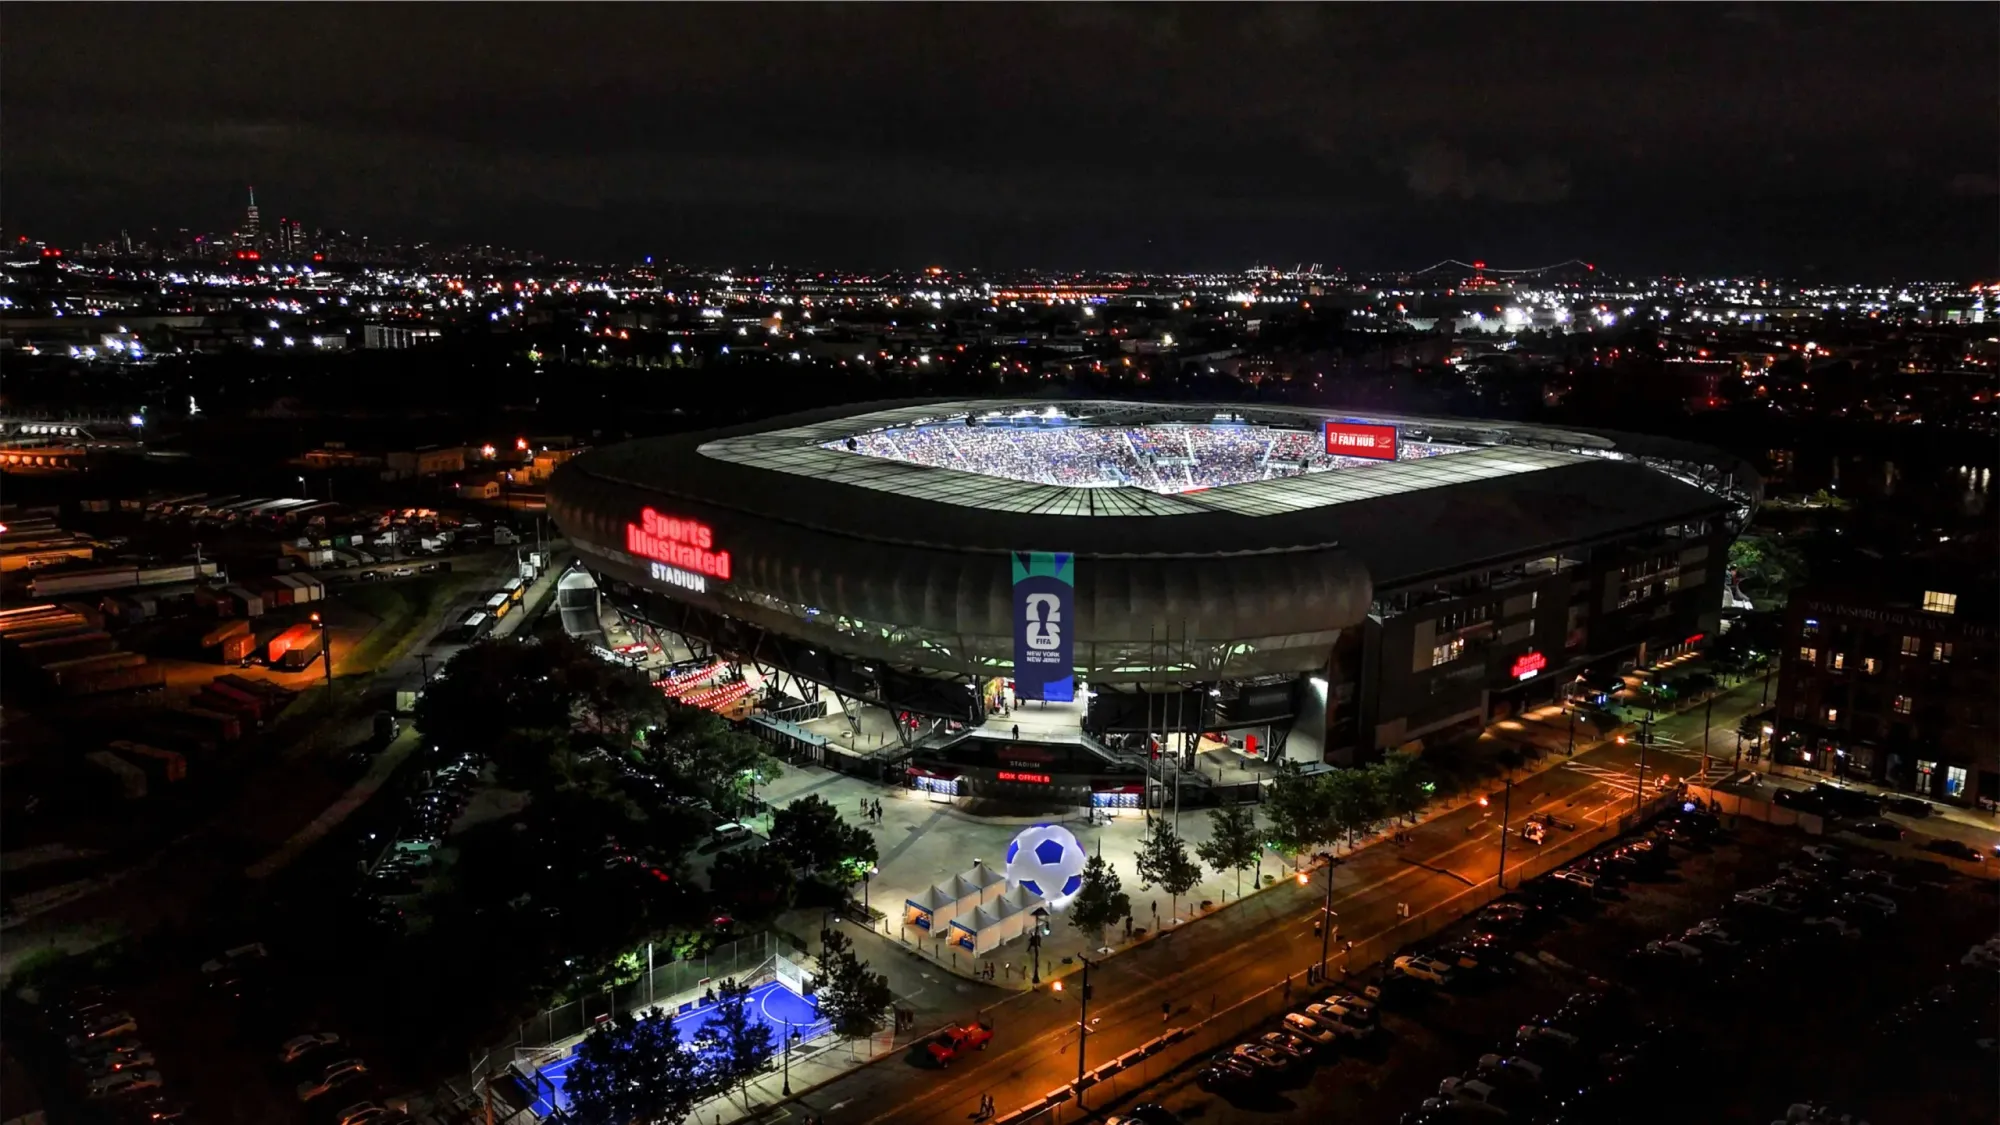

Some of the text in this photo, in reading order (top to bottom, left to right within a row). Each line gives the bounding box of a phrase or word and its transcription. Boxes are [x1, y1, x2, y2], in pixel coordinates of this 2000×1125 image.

[1338, 435, 1356, 446] FAN
[1356, 436, 1375, 447] HUB
[642, 506, 712, 549] Sports
[627, 522, 731, 579] Illustrated
[651, 562, 705, 594] STADIUM
[1026, 656, 1042, 664] NEW
[1042, 650, 1060, 658] YORK
[1009, 760, 1040, 768] STADIUM
[998, 771, 1016, 780] BOX
[1017, 773, 1042, 783] OFFICE
